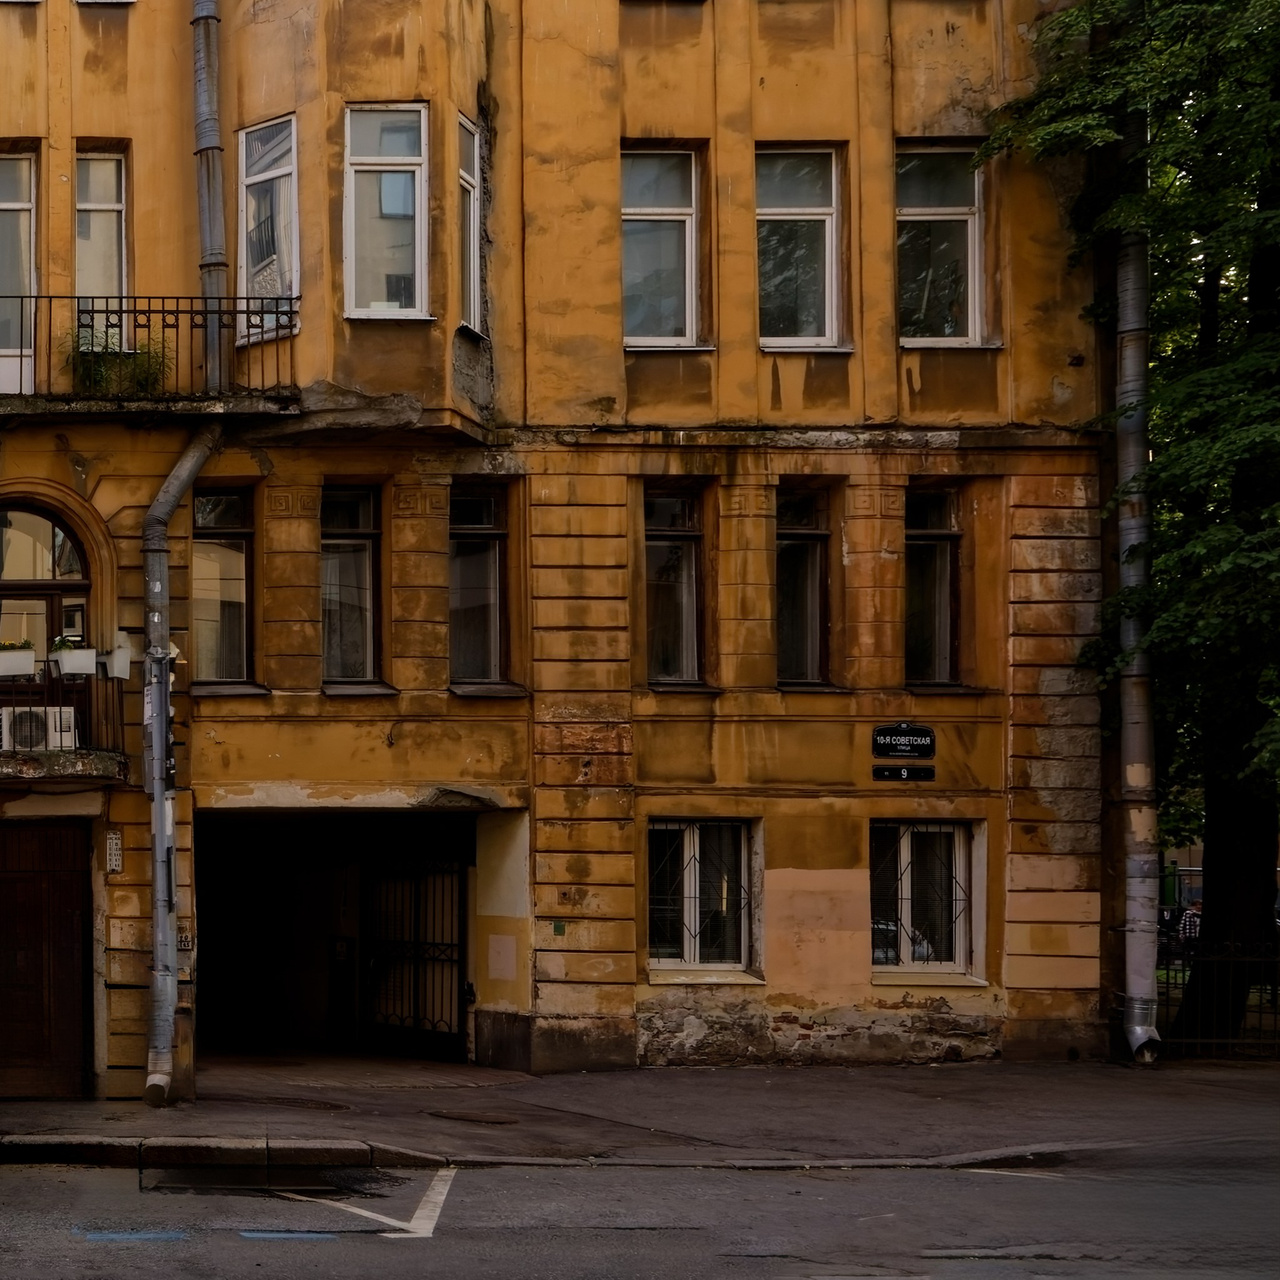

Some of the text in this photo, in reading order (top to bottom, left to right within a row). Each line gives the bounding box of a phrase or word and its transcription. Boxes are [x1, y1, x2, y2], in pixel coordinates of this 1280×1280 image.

[877, 736, 930, 745] 10-Я СОВЕТСКАЯ
[902, 768, 908, 778] 9
